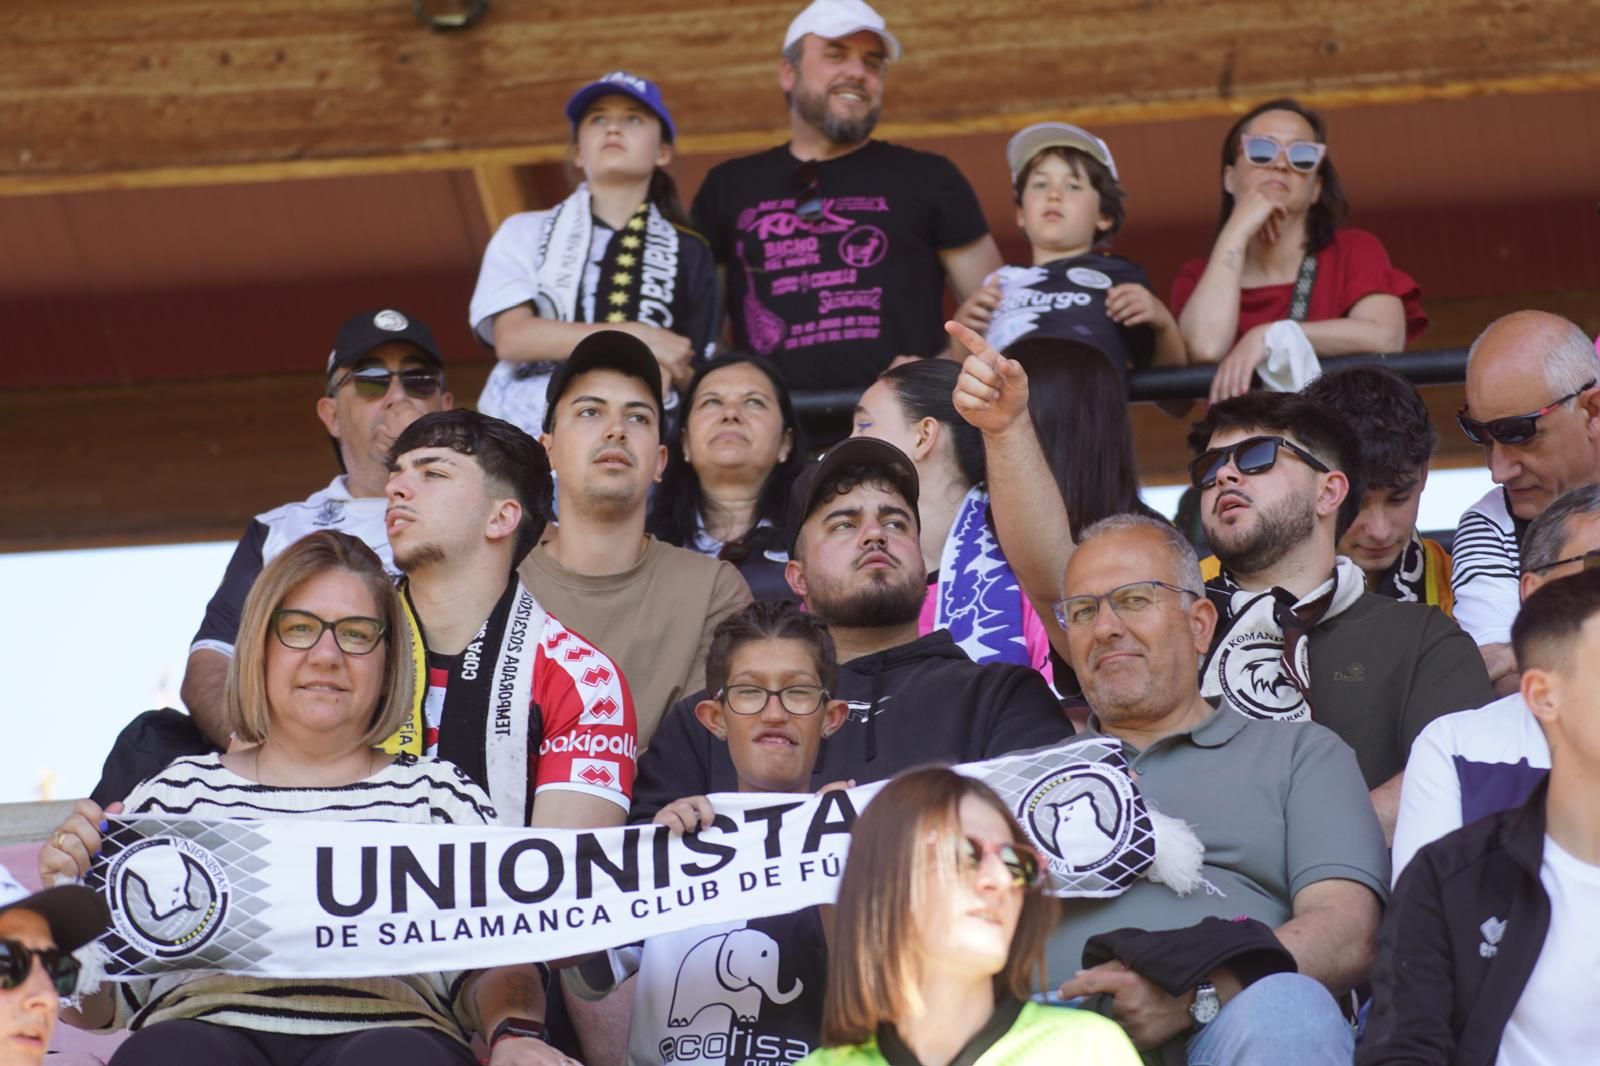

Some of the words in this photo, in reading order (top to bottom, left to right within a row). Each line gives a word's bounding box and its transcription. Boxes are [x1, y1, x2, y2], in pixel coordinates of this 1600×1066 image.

[460, 639, 486, 681] COPA
[1228, 631, 1285, 649] KOMAND
[1280, 706, 1307, 722] ARRI
[316, 789, 859, 918] UNIONISTA
[315, 924, 358, 949] DE
[378, 904, 612, 947] SALAMANCA
[630, 879, 719, 919] CLUB
[739, 865, 782, 892] DE
[800, 852, 840, 882] FÚ
